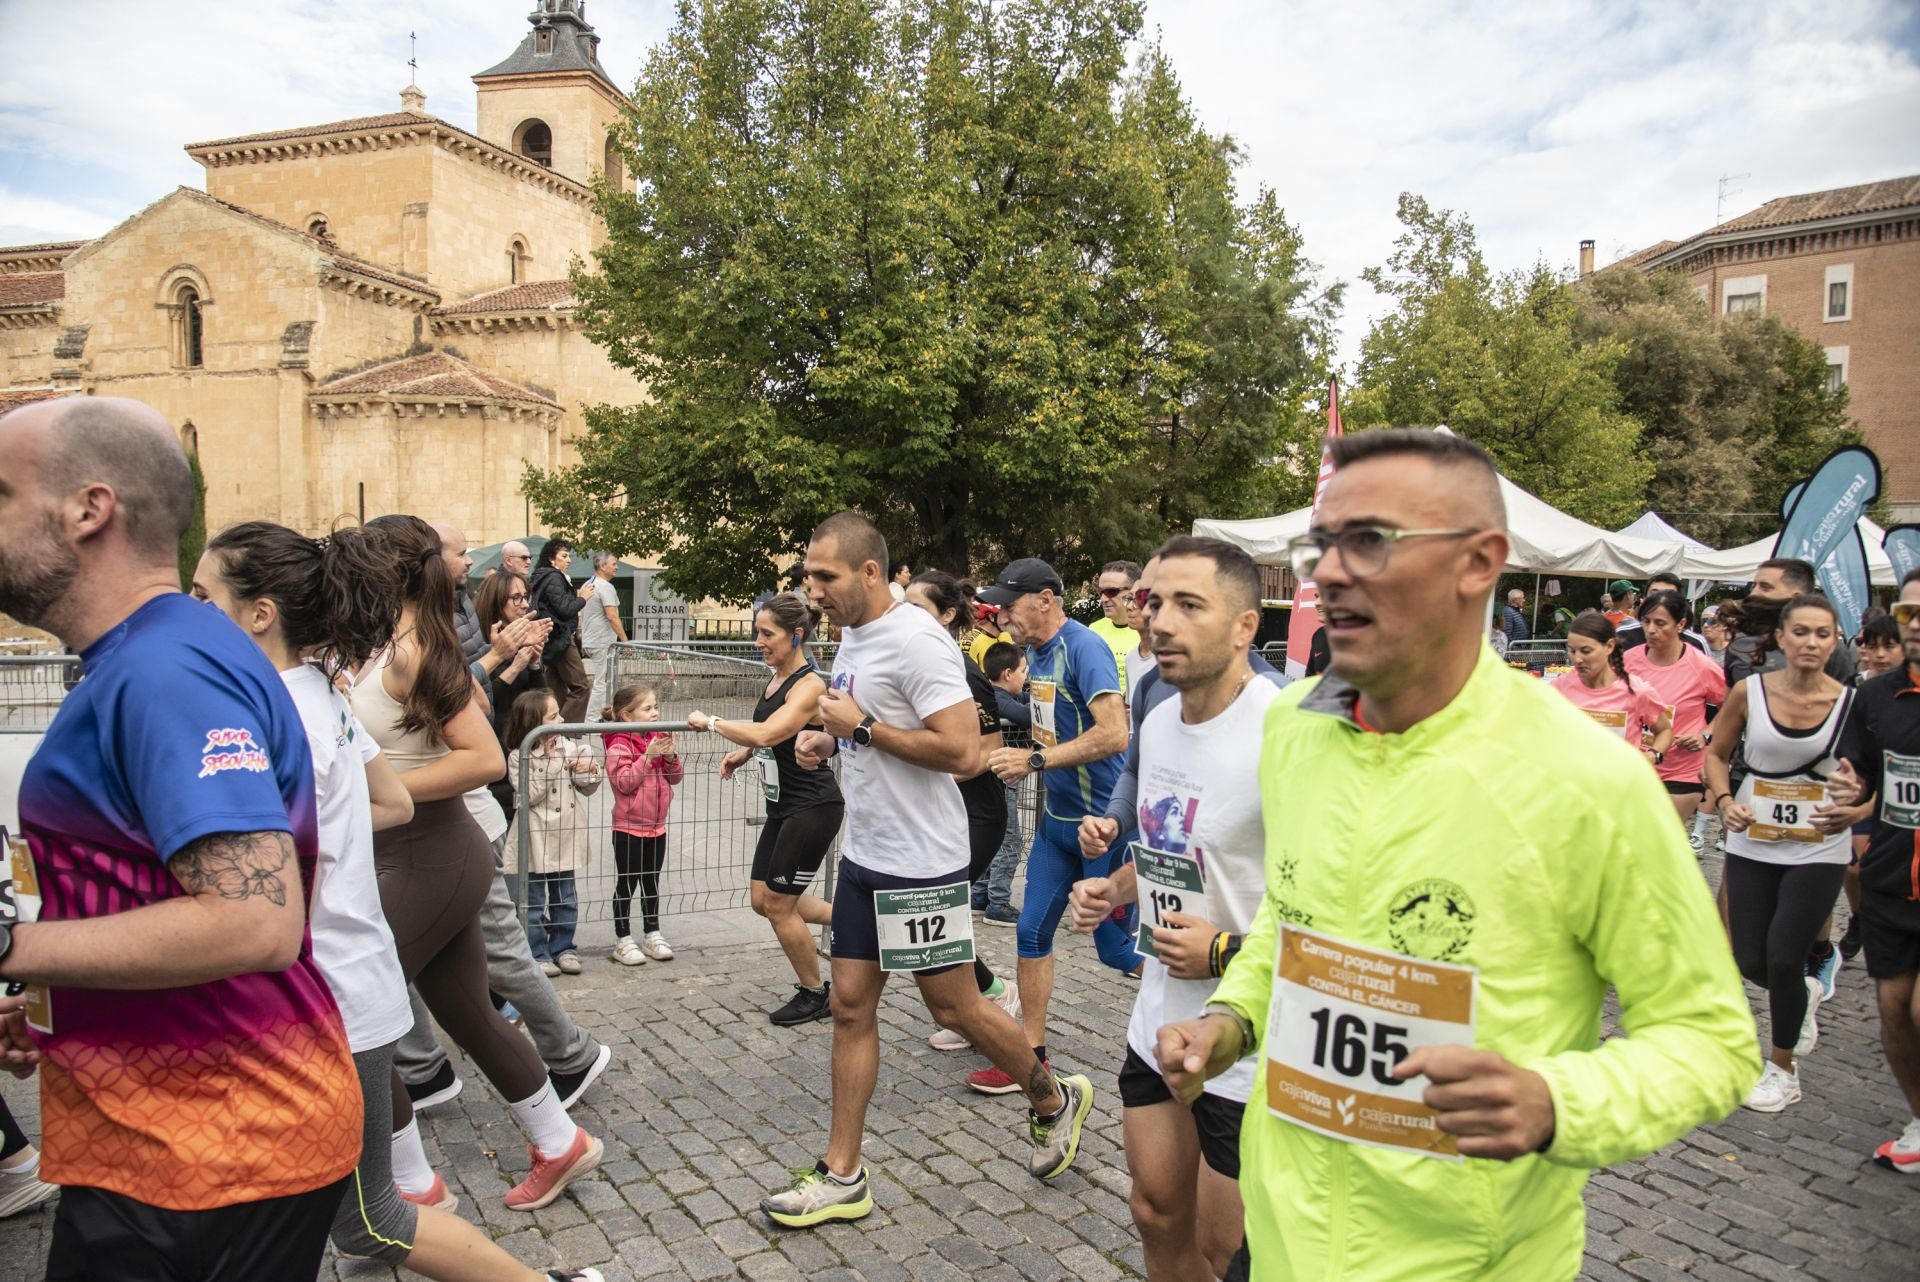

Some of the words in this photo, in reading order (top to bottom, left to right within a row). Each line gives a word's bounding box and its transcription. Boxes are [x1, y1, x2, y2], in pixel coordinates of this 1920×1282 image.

[638, 605, 685, 615] RESANAR
[1772, 803, 1798, 825] 43
[914, 891, 938, 900] popular
[929, 903, 951, 911] CÁNCER
[904, 915, 946, 944] 112
[1301, 938, 1342, 963] Carrera
[1343, 954, 1395, 976] popular
[1398, 967, 1408, 979] 4
[1411, 967, 1440, 986] km.
[1328, 967, 1396, 994] cajarural
[1308, 976, 1350, 999] CONTRA
[1351, 990, 1366, 1003] EL
[1368, 990, 1422, 1015] CÁNCER
[1310, 1007, 1409, 1086] 165
[1279, 1080, 1332, 1109] cajaviva
[1359, 1106, 1437, 1130] cajarural
